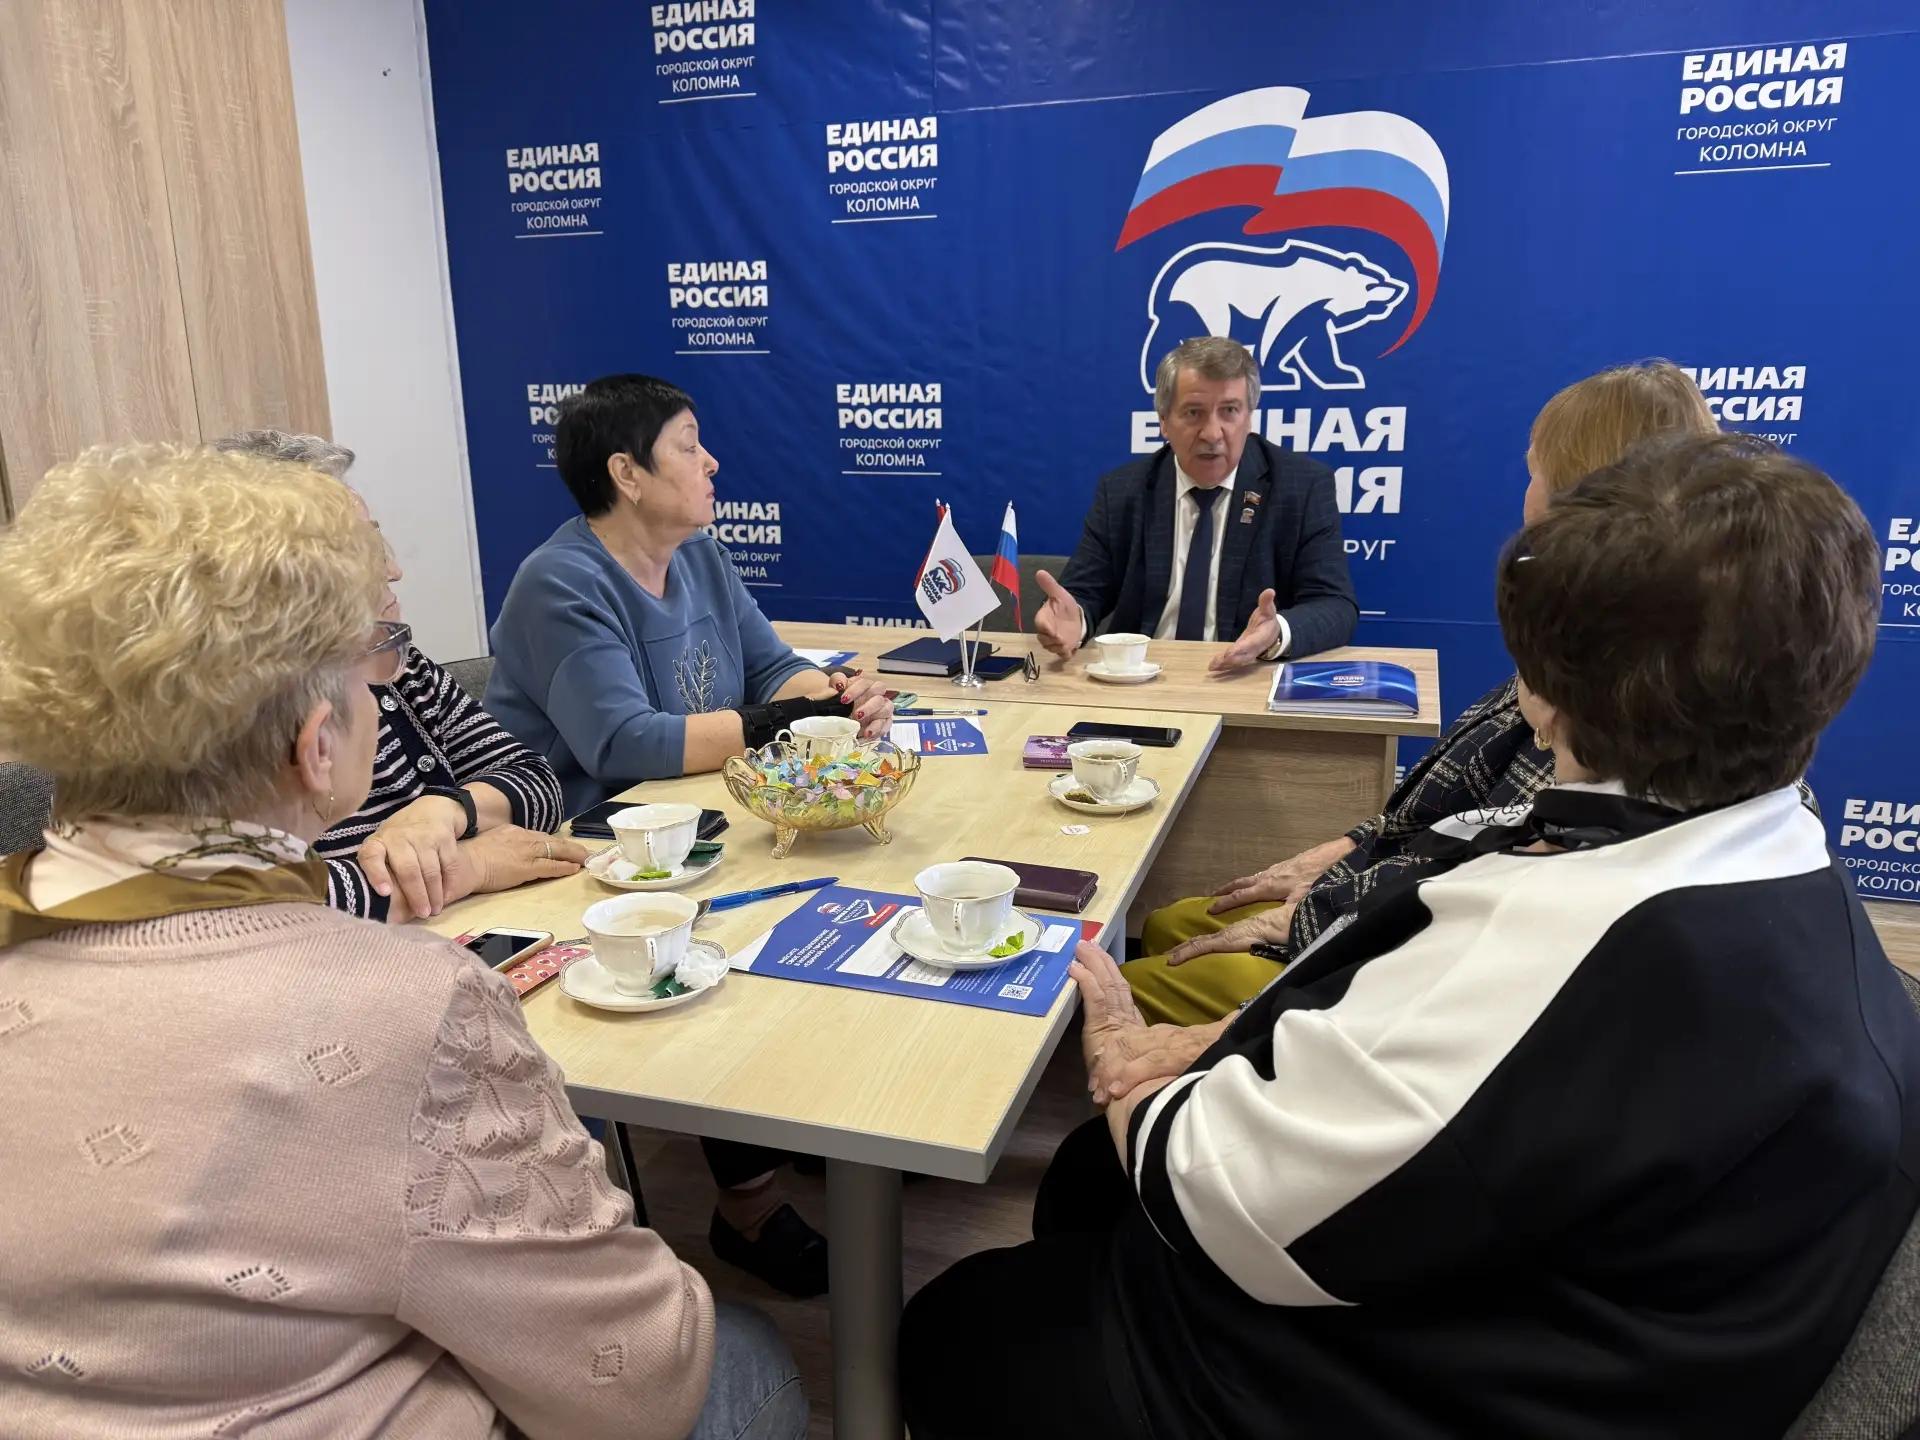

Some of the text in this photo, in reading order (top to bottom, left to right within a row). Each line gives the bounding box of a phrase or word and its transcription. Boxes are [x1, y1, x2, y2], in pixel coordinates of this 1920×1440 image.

[651, 0, 755, 28] ЕДИНАЯ
[654, 23, 755, 54] РОССИЯ
[656, 56, 755, 75] ГОРОДСКОЙ ОКРУГ
[1682, 43, 1848, 83] ЕДИНАЯ
[672, 74, 740, 93] КОЛОМНА
[1680, 76, 1843, 115] РОССИЯ
[827, 116, 937, 147] ЕДИНАЯ
[1677, 117, 1838, 140] ГОРОДСКОЙ ОКРУГ
[506, 142, 599, 169] ЕДИНАЯ
[828, 144, 938, 173] РОССИЯ
[1699, 140, 1807, 162] КОЛОМНА
[509, 167, 601, 193] РОССИЯ
[829, 177, 938, 195] ГОРОДСКОЙ ОКРУГ
[511, 197, 602, 213] ГОРОДСКОЙ ОКРУГ
[846, 196, 920, 213] КОЛОМНА
[526, 214, 589, 229] КОЛОМНА
[667, 260, 767, 283] ЕДИНАЯ
[670, 285, 768, 309] РОССИЯ
[672, 315, 769, 329] ГОРОДСКОЙ ОКРУГ
[688, 332, 755, 346] КОЛОМНА
[1680, 366, 1806, 391] ИНАЯ
[527, 383, 587, 404] ЕДИН
[836, 383, 942, 405] ЕДИНАЯ
[838, 408, 942, 430] РОССИЯ
[1704, 396, 1803, 422] ССИЯ
[1130, 406, 1407, 454] ЕНАЯ
[839, 437, 942, 450] ГОРОДСКОЙ ОКРУГ
[855, 453, 926, 467] КОЛОМНА
[715, 501, 780, 520] ИНАЯ
[699, 523, 782, 545] ОССИЯ
[750, 552, 782, 563] ОКРУГ
[1343, 540, 1396, 560] РУГ
[921, 577, 938, 605] ОССИЯ
[1843, 798, 1920, 826] ЕДИ
[1840, 824, 1920, 853] РОС
[1857, 874, 1920, 893] КОЛО
